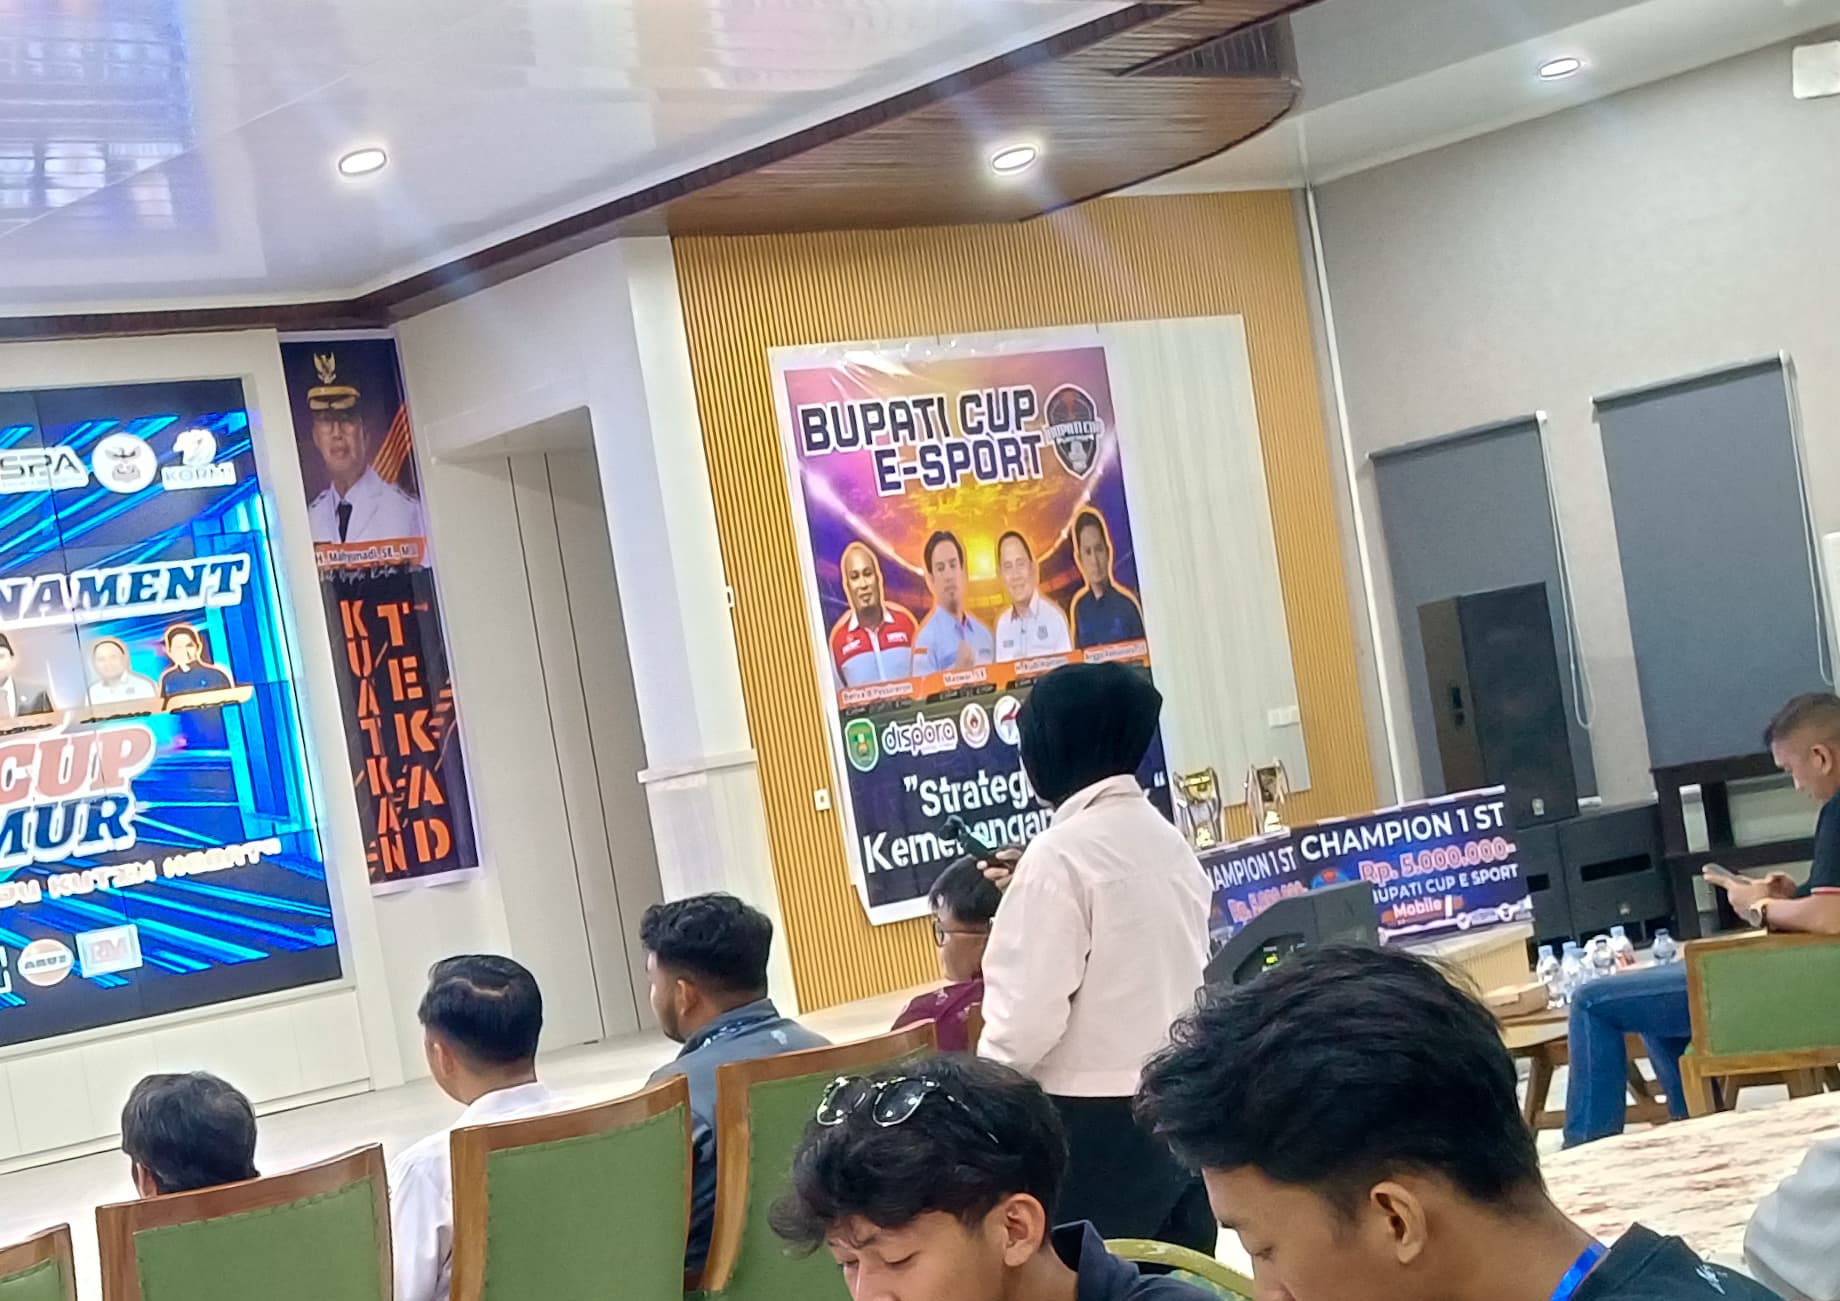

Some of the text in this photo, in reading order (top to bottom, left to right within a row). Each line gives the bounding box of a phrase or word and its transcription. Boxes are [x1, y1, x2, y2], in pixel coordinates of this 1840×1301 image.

[801, 388, 1036, 452] BUPATI CUP
[874, 434, 1043, 492] E-SPORT
[885, 714, 956, 753] dispora
[1301, 802, 1505, 861] CHAMPION 1 ST
[1207, 852, 1272, 892] AMPION
[1277, 846, 1297, 873] ST
[1359, 859, 1399, 888] Rp.
[1425, 875, 1456, 894] CUP
[1459, 872, 1470, 888] E
[1470, 863, 1519, 886] SPORT
[1392, 896, 1443, 919] Mobile
